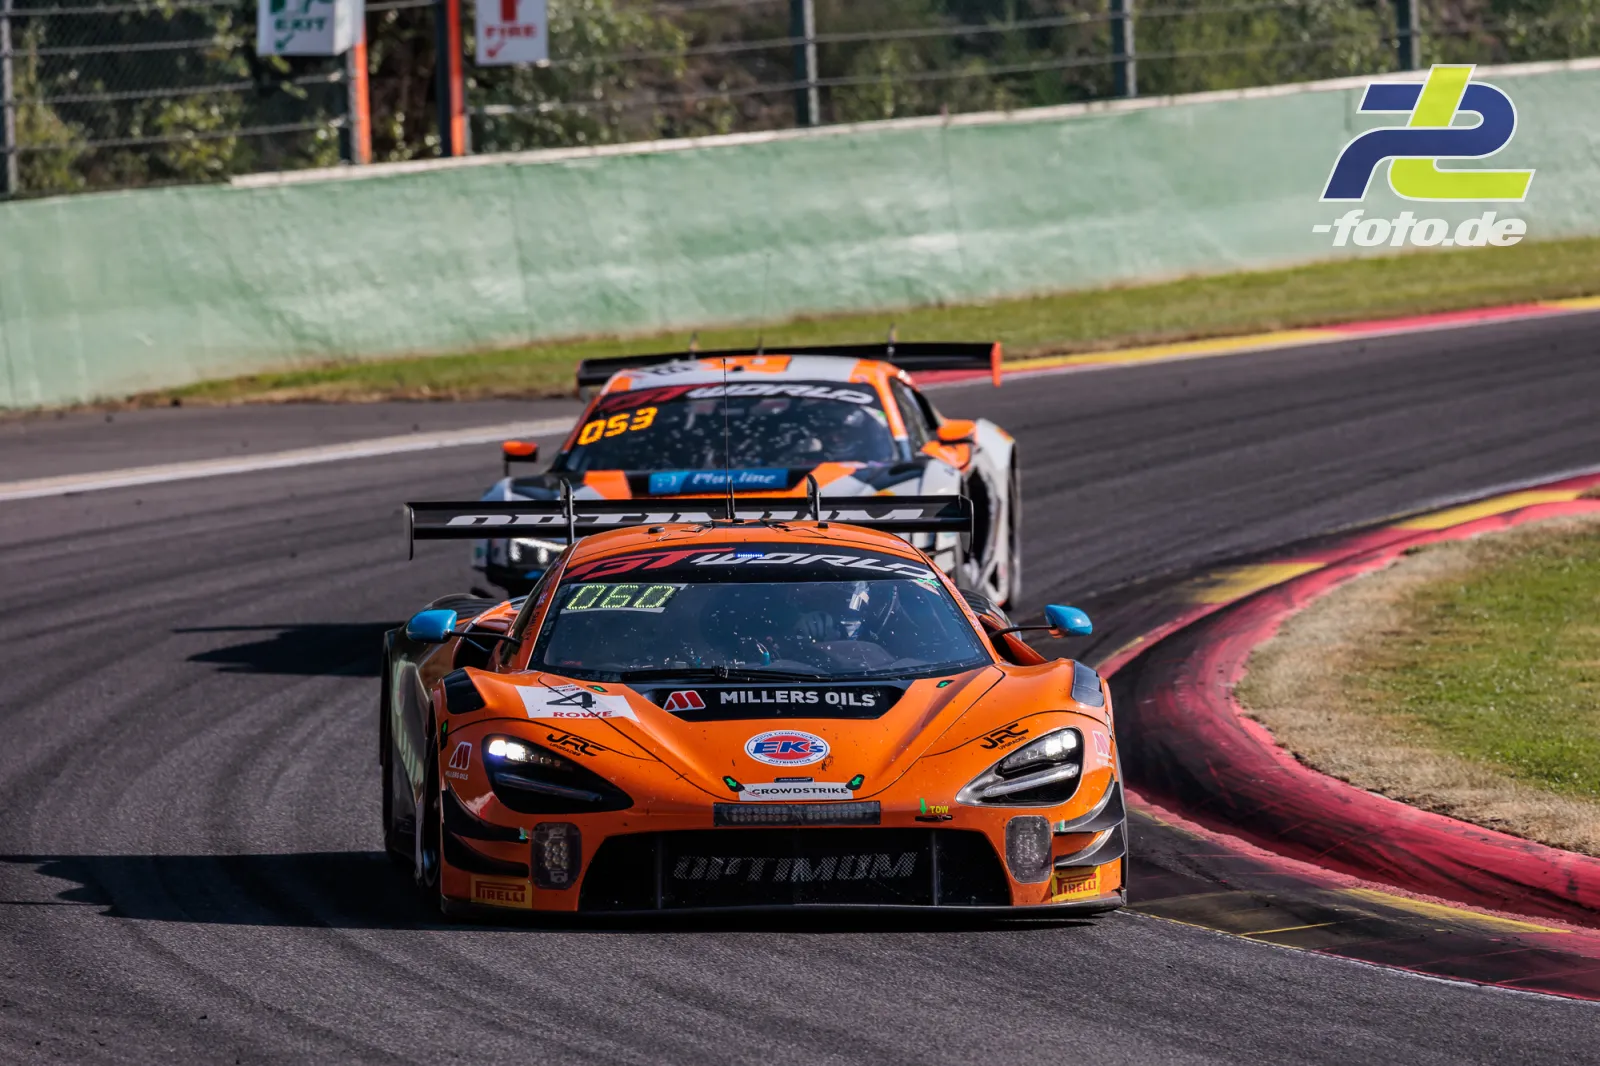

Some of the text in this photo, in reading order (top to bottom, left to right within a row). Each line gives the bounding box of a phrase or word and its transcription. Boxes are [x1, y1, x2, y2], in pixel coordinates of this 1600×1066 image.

[274, 17, 326, 32] EXIT
[485, 24, 537, 39] FIRE
[685, 383, 874, 405] WORLD
[577, 407, 658, 446] 053
[563, 548, 938, 582] GT WORLD
[566, 584, 676, 611] 060
[546, 691, 597, 709] 4
[720, 690, 876, 707] MILLERS OILS
[553, 710, 613, 718] ROWE
[546, 733, 607, 757] JRC
[753, 741, 824, 754] EK's
[980, 723, 1029, 750] JRC
[752, 787, 848, 795] CROWDSTRIKE
[930, 805, 949, 814] TOW
[674, 852, 918, 882] OPTIMUM
[475, 878, 526, 903] PIRELLI
[1056, 872, 1097, 895] PIRELLI
